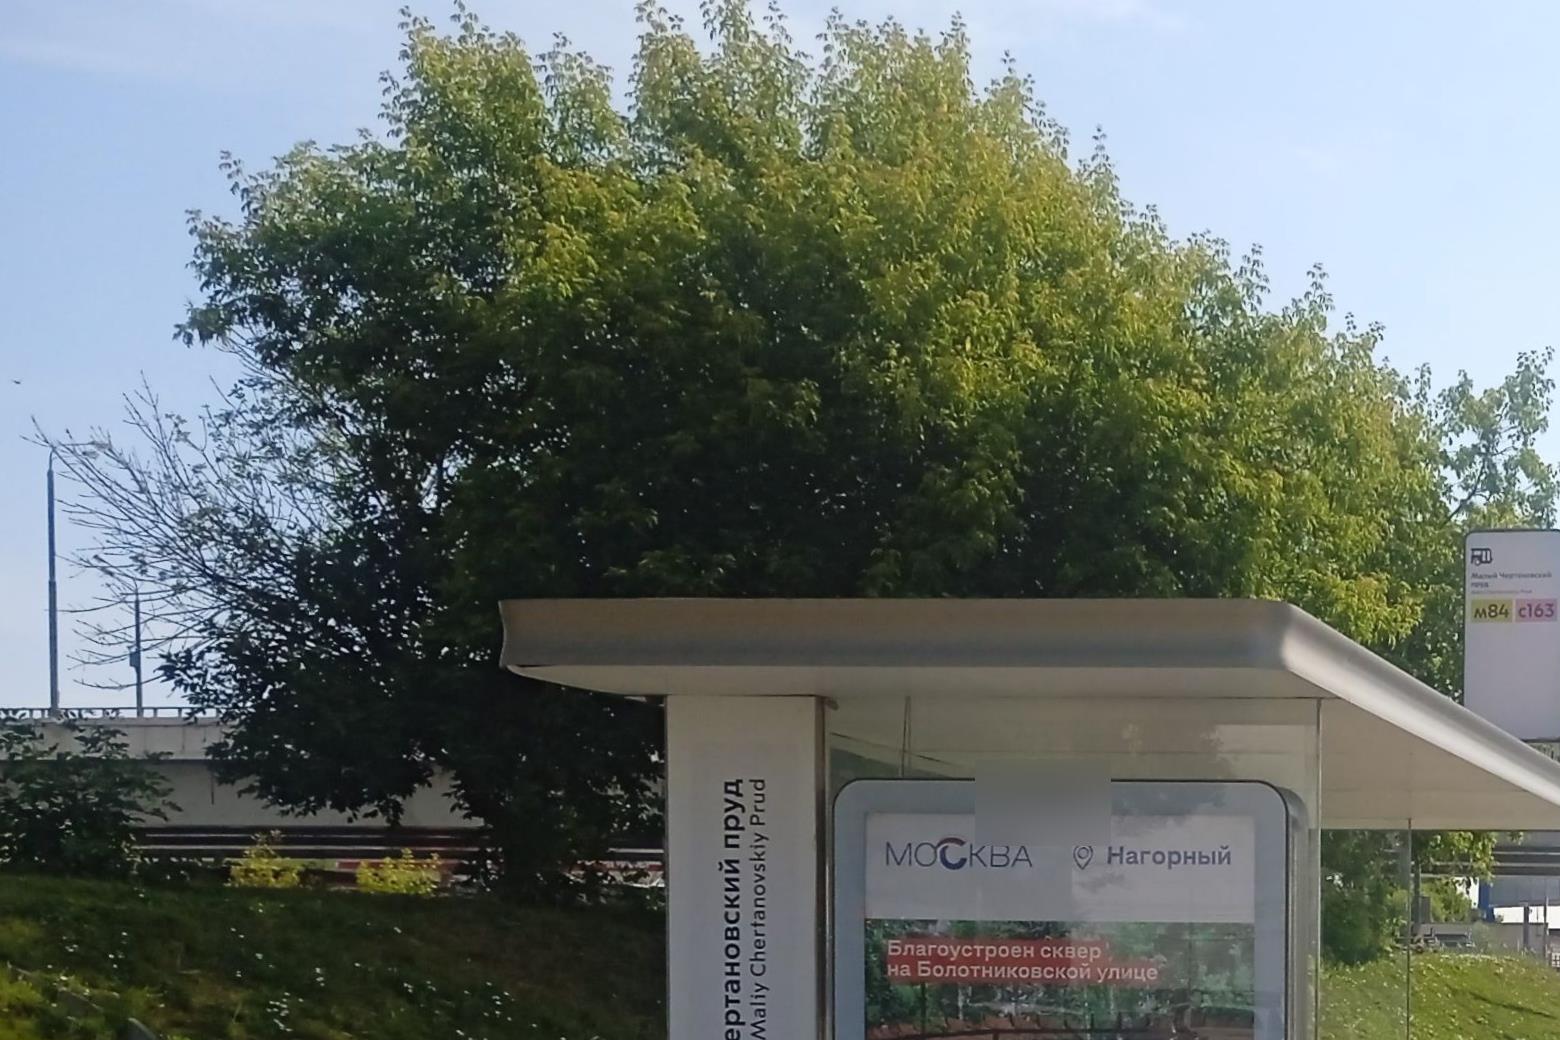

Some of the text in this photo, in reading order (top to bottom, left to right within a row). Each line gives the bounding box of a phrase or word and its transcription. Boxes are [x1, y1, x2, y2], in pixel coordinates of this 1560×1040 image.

[1473, 602, 1554, 619] м84 с163
[720, 778, 745, 850] пруд
[749, 778, 766, 827] Prud
[884, 836, 1034, 870] МОСКВА
[1106, 844, 1233, 870] Нагорный
[749, 831, 770, 977] Chertanovskiy
[887, 940, 1102, 963] Благоустроен сквер
[887, 961, 1158, 983] на Болотниковской улице
